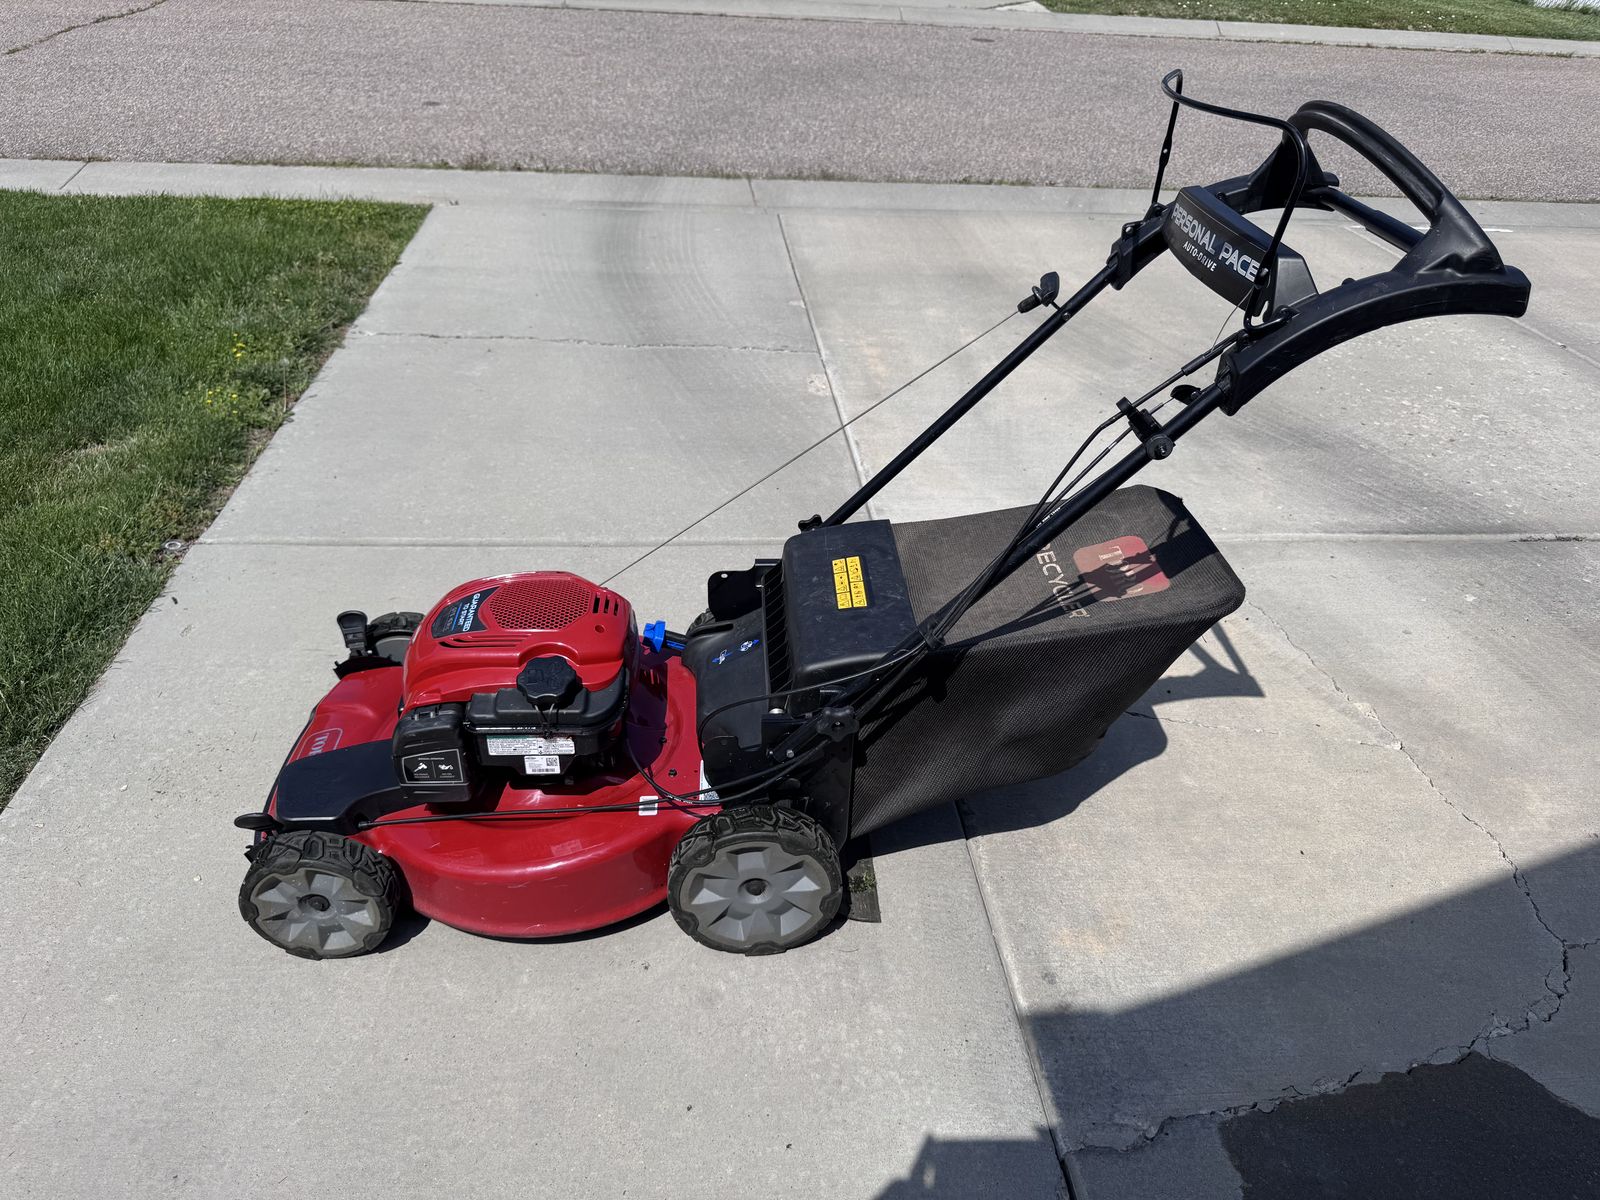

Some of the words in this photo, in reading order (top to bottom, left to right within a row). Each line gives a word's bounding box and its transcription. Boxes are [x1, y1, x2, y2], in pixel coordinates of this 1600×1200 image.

[1171, 203, 1216, 254] PERSONAL
[1218, 241, 1261, 282] PACE
[1182, 241, 1217, 272] AUTO-DRIVE
[1036, 544, 1090, 618] ECYCLER
[463, 593, 481, 632] GUARANTEED
